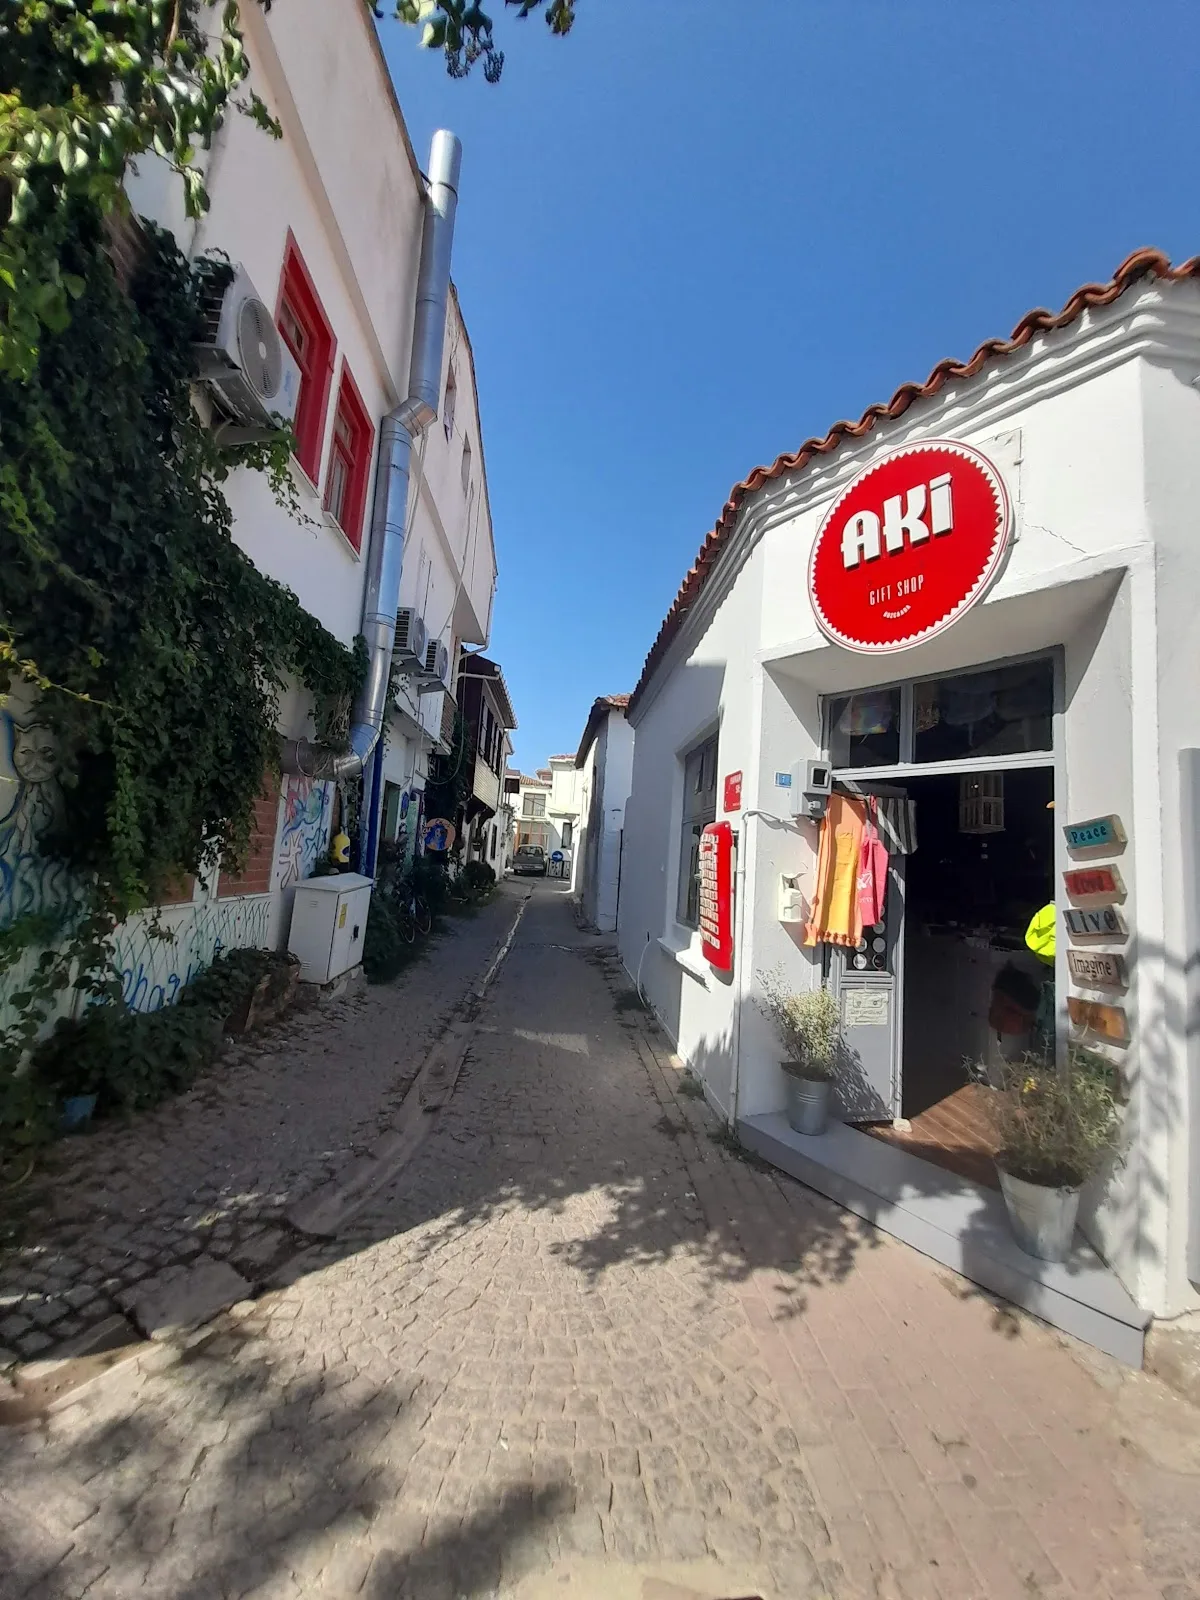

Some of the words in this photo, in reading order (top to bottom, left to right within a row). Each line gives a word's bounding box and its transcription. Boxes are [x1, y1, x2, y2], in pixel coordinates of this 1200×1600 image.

[869, 585, 891, 606] GIFT
[897, 574, 924, 597] SHOP
[1071, 825, 1107, 843] Peace
[1067, 910, 1116, 933] Live
